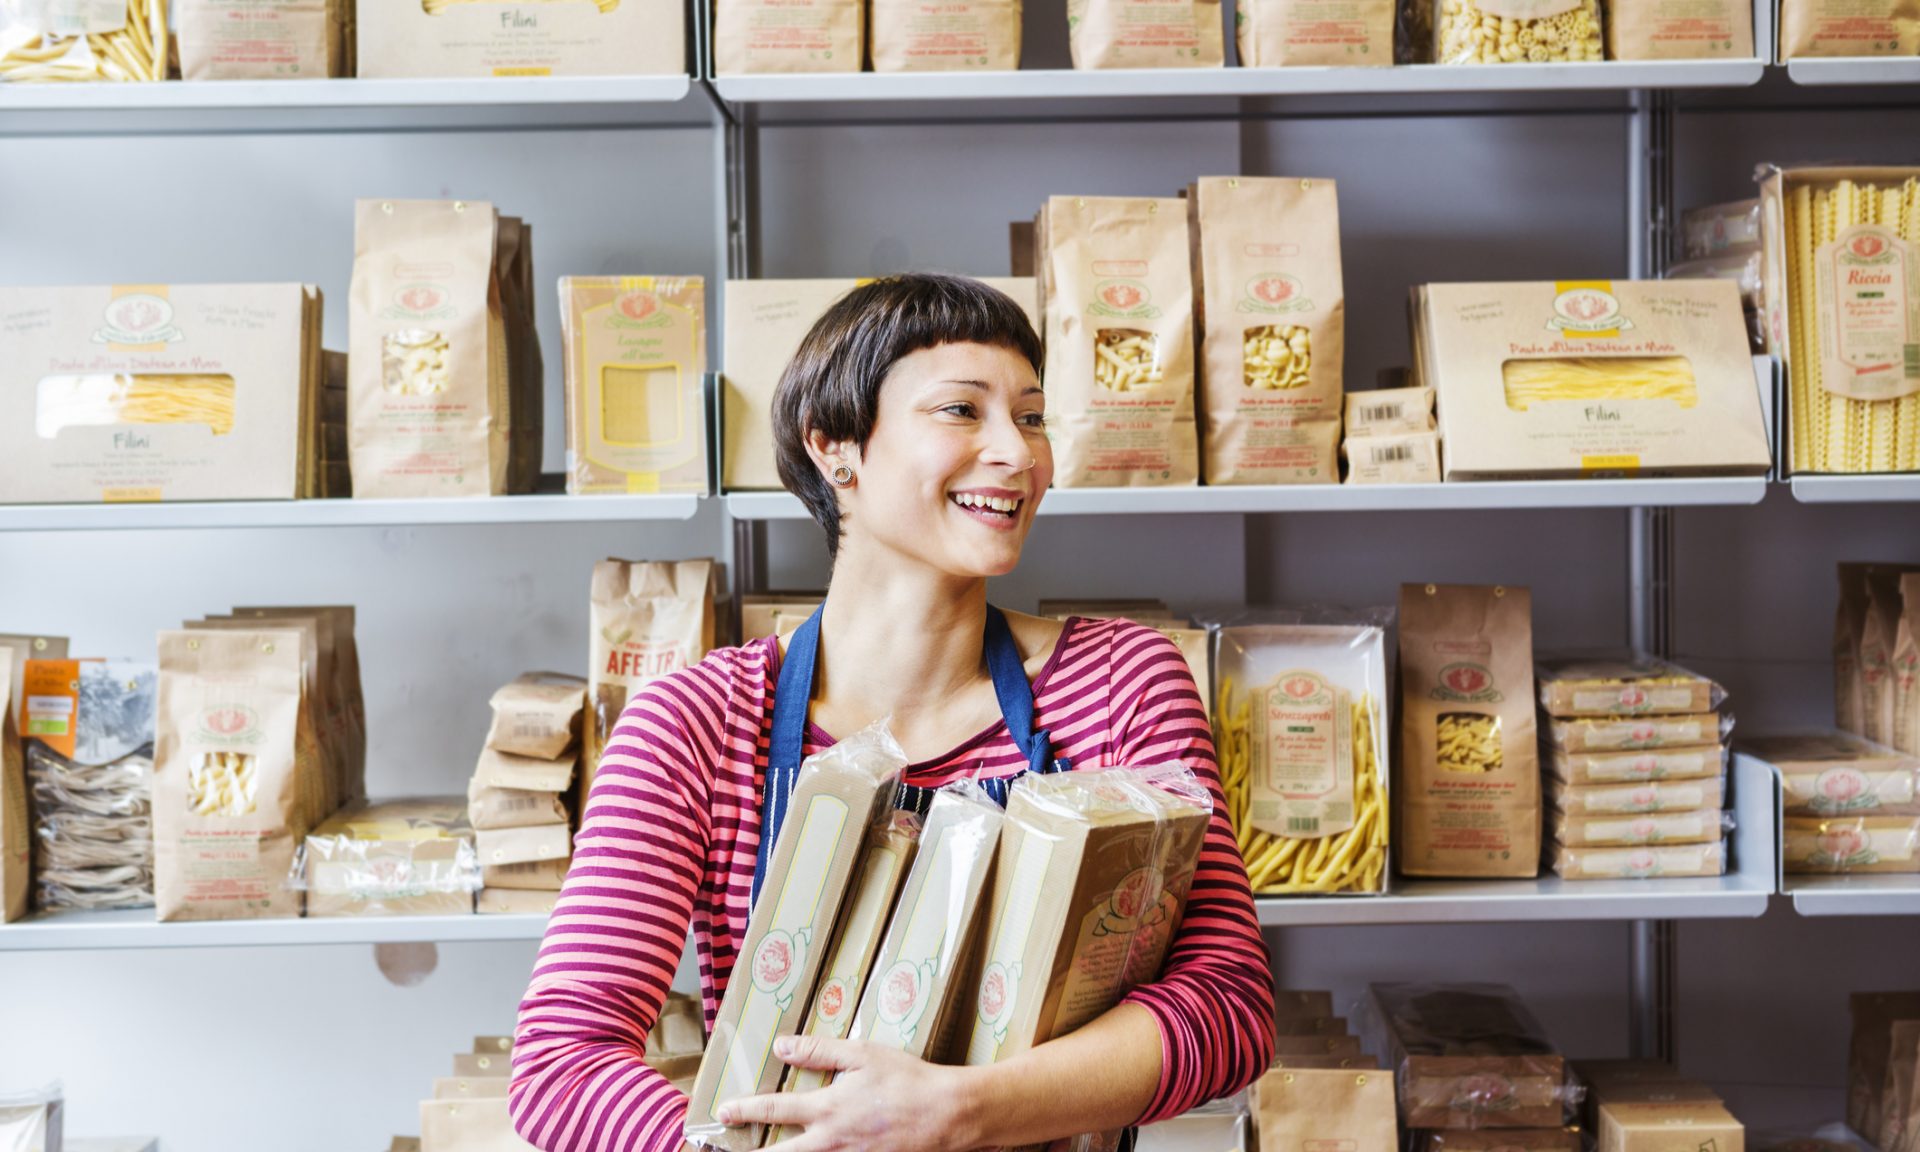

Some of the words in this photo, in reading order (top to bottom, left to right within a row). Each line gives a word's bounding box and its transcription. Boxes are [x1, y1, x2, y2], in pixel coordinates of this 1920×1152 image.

[500, 10, 537, 28] Filini
[1848, 268, 1892, 285] Riccia
[1584, 405, 1620, 421] Filini
[113, 432, 150, 449] Filini
[606, 647, 688, 677] AFELTRA
